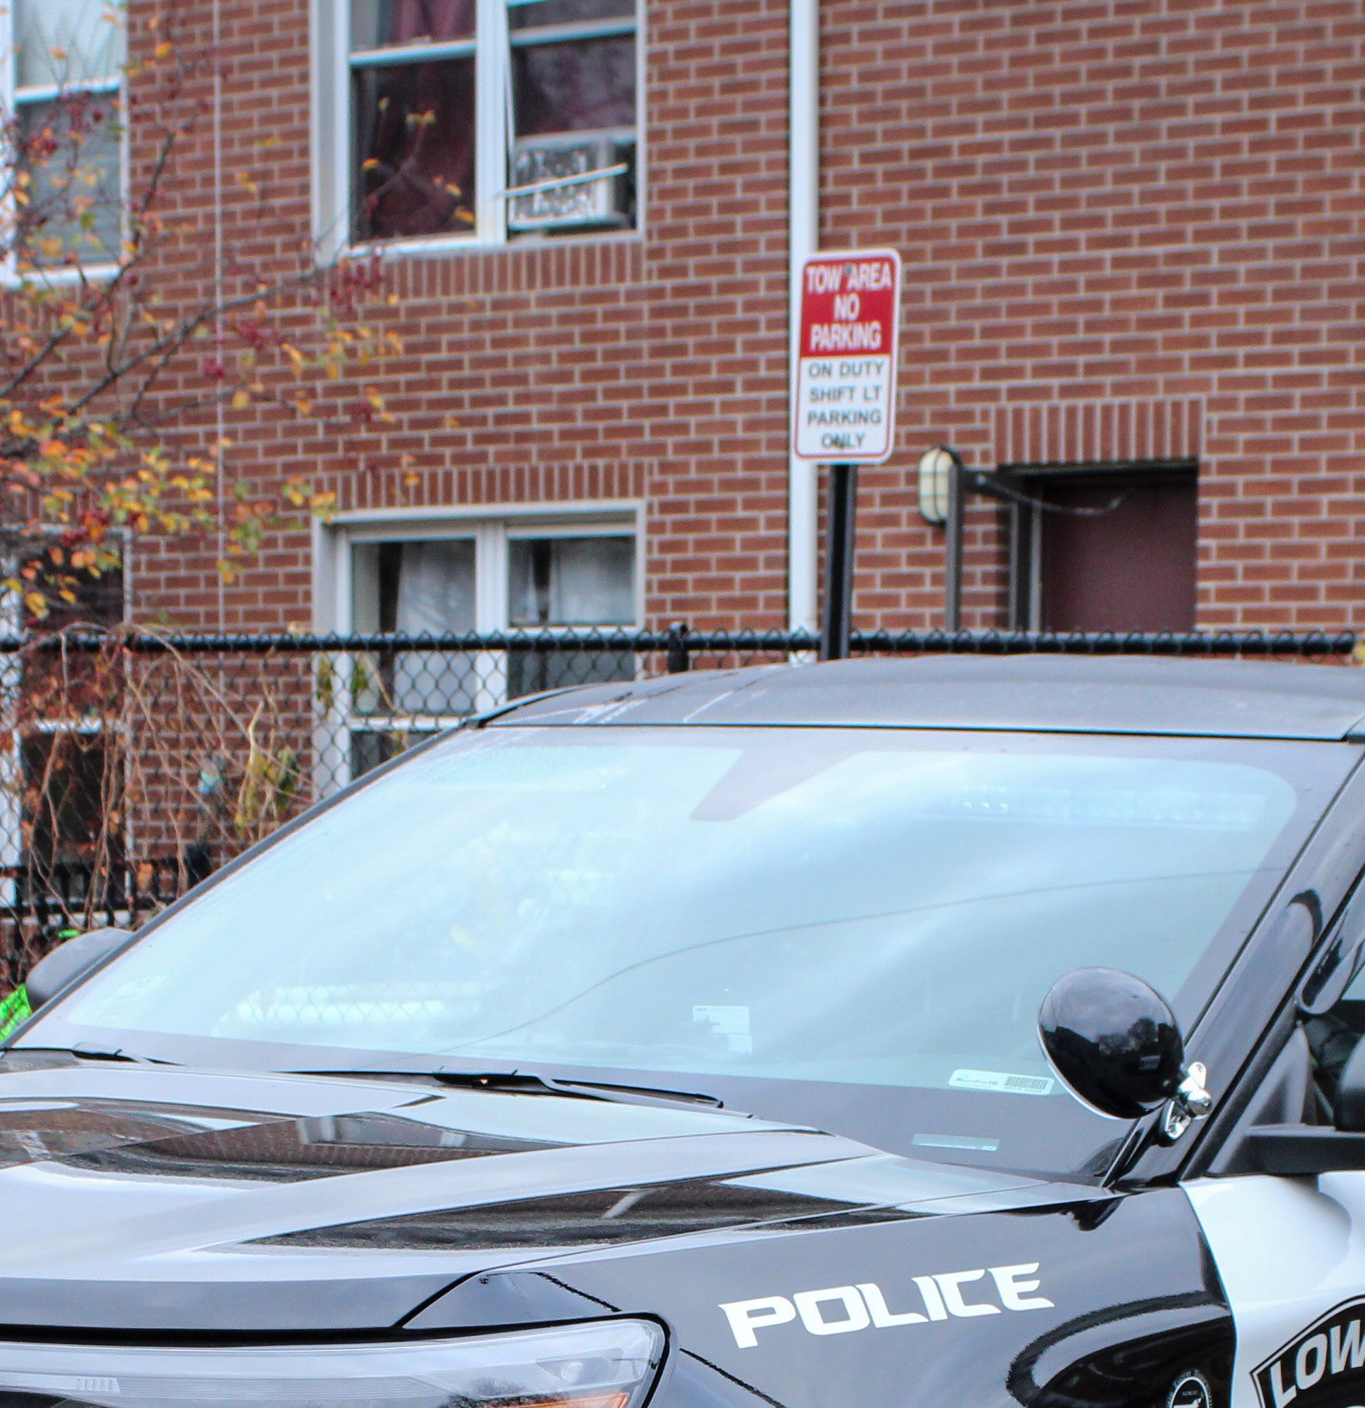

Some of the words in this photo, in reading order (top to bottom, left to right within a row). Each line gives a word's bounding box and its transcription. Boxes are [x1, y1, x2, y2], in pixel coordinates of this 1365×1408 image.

[806, 264, 842, 294] TOW
[846, 262, 892, 291] AREA
[834, 293, 860, 322] NO
[809, 321, 882, 351] PARKING
[808, 362, 833, 378] ON
[839, 360, 885, 377] DUTY
[808, 386, 856, 402] SHIFT
[862, 384, 883, 400] LT
[806, 407, 882, 426] PARKING
[717, 1262, 1055, 1349] POLICE
